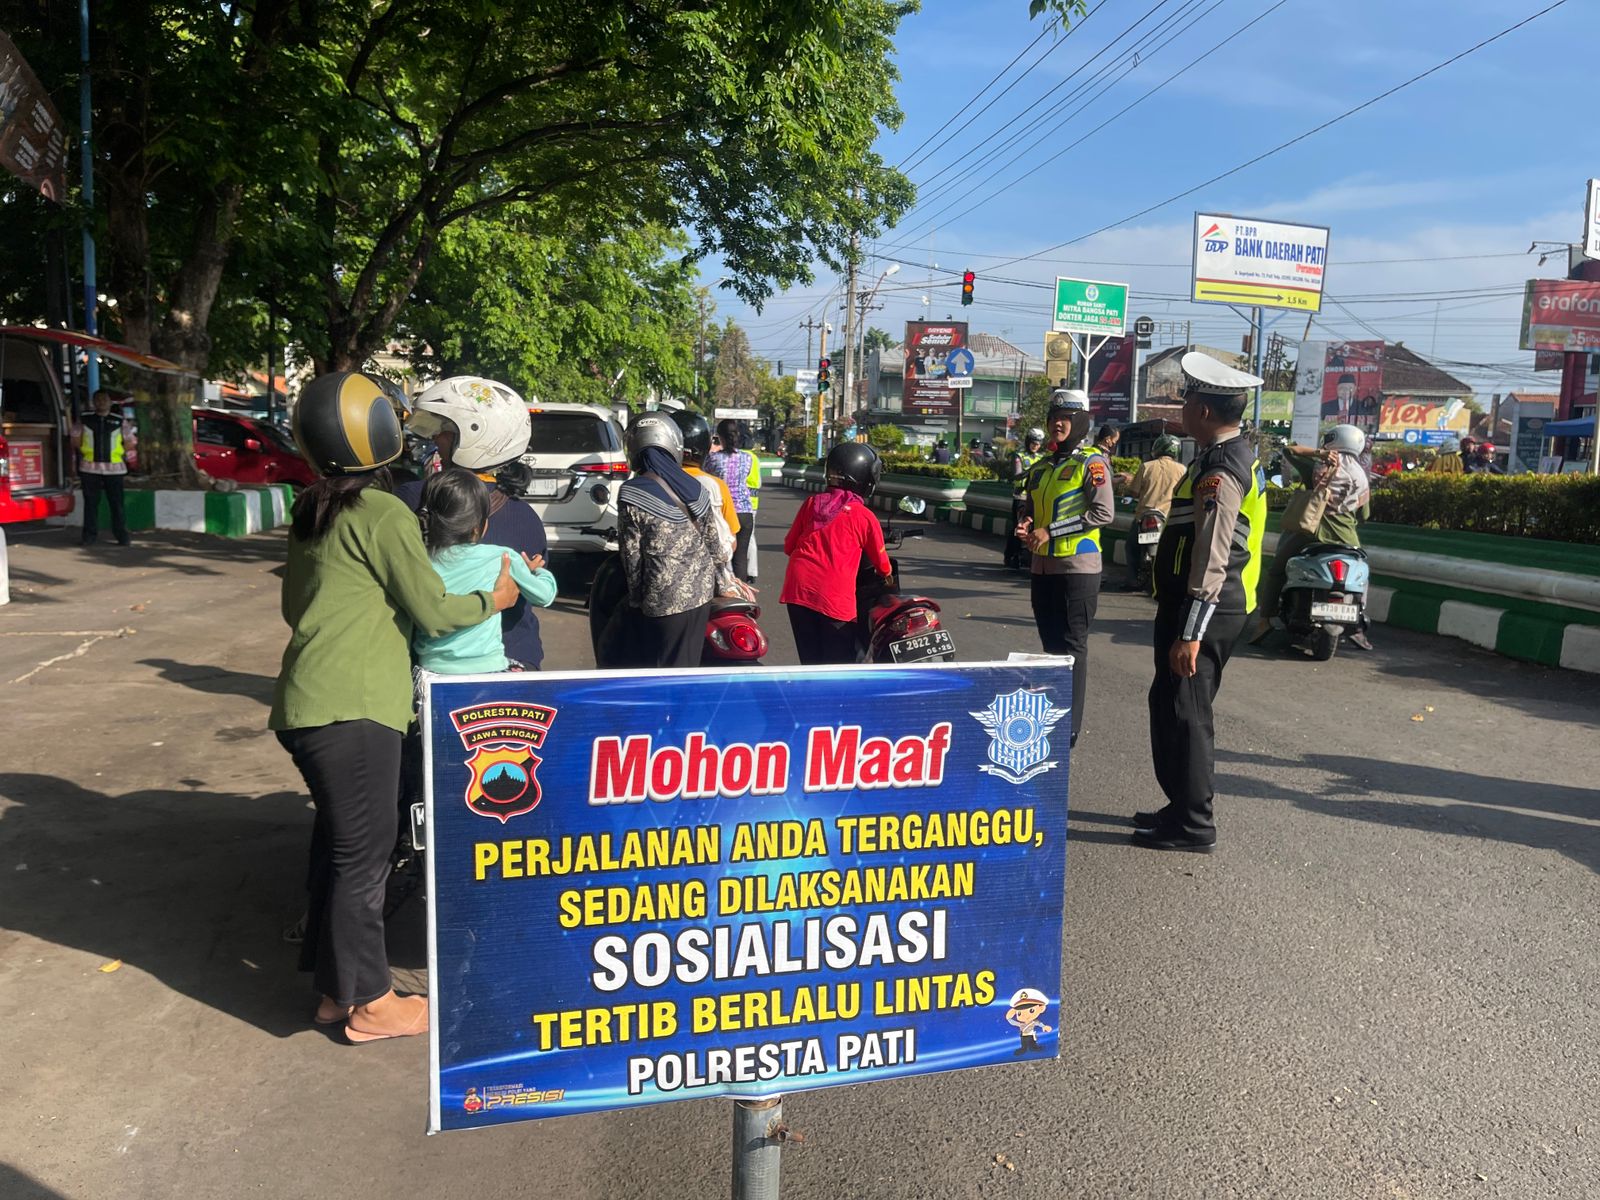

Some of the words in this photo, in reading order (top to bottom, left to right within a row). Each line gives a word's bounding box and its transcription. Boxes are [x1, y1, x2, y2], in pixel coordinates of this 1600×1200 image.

[1235, 237, 1264, 259] BANK
[1265, 240, 1304, 263] DAERAH
[1305, 245, 1325, 266] PATI
[1058, 312, 1082, 321] DOKTER
[1083, 315, 1099, 323] JAGA
[1063, 305, 1081, 313] MITRA
[1082, 307, 1105, 316] BANGSA
[1106, 309, 1119, 317] PATI
[893, 644, 901, 654] K
[906, 637, 930, 650] 2822
[935, 632, 948, 643] PS
[462, 708, 519, 722] POLRESTA
[521, 709, 545, 721] PATI
[471, 730, 497, 741] JAWA
[500, 729, 538, 741] TENGAH
[590, 733, 789, 803] Mohon
[805, 723, 951, 790] Maaf
[474, 826, 719, 880] PERJALANAN
[731, 820, 827, 860] ANDA
[837, 808, 1044, 855] TERGANGGU,
[559, 880, 706, 928] SEDANG
[719, 863, 974, 915] DILAKSANAKAN
[592, 909, 947, 991] SOSIALISASI
[534, 1001, 678, 1050] TERTIB
[693, 983, 860, 1034] BERLALU
[875, 970, 995, 1016] LINTAS
[627, 1039, 826, 1095] POLRESTA
[839, 1029, 915, 1070] PATI
[487, 1089, 565, 1109] PRESISI
